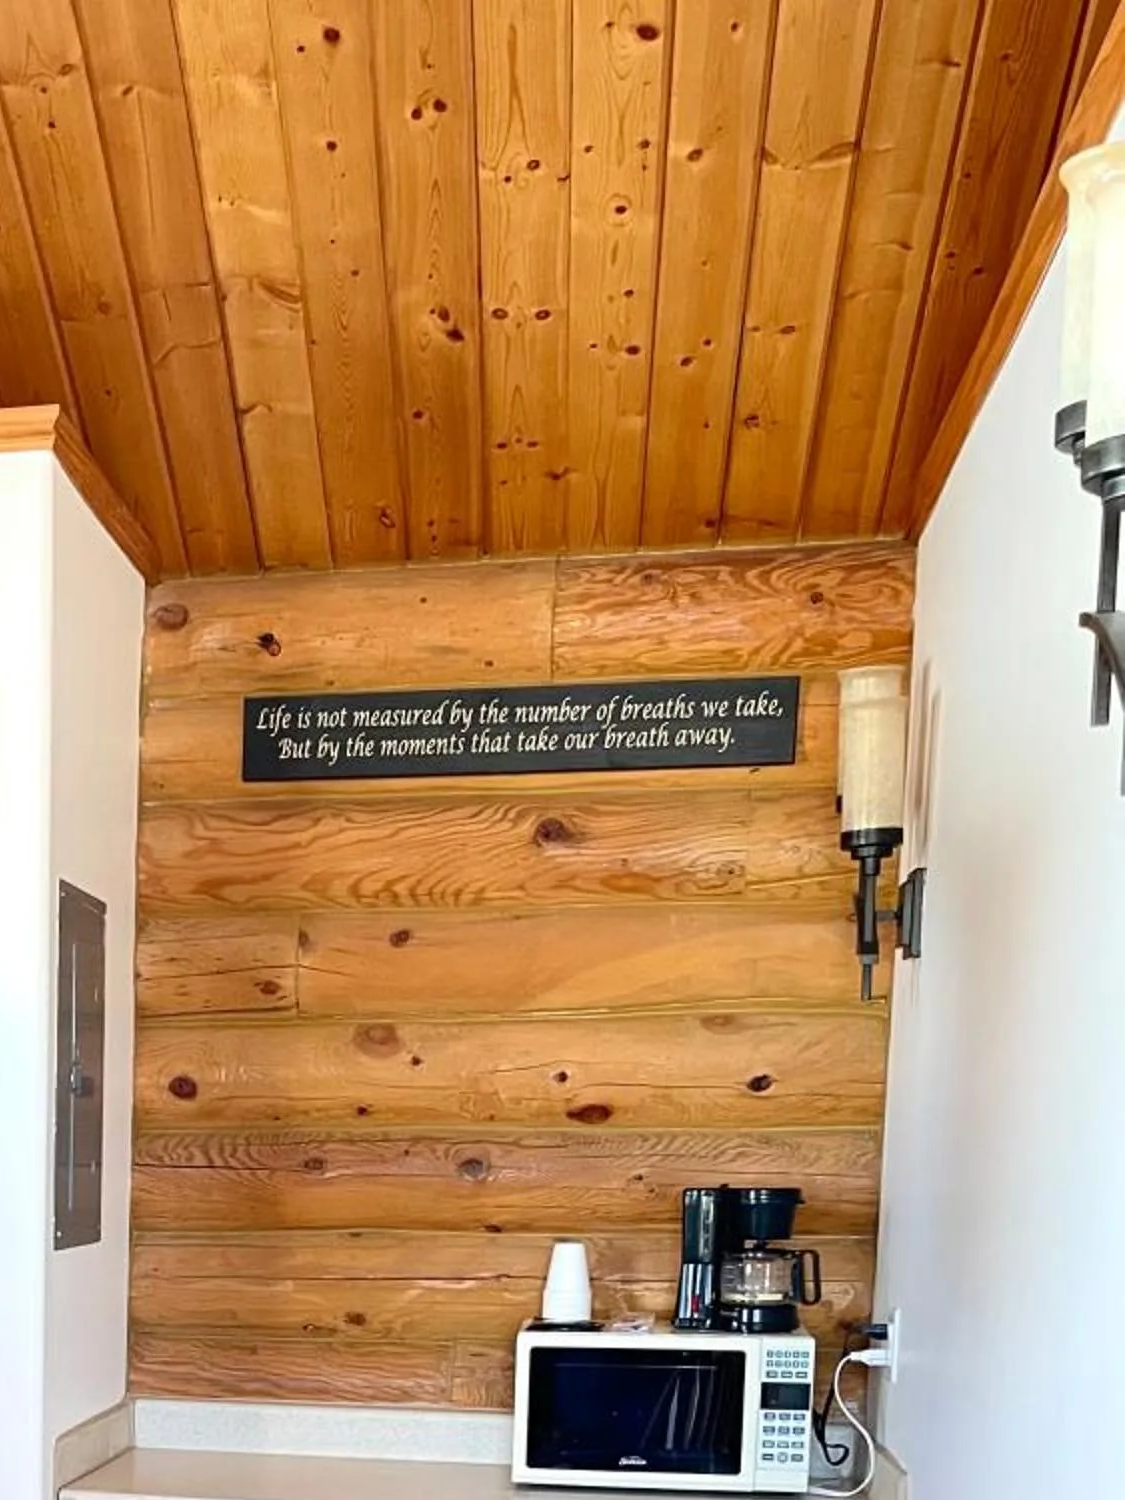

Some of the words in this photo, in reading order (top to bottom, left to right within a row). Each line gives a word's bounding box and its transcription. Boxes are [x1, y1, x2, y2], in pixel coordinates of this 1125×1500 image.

[256, 703, 292, 737] Life
[297, 707, 310, 729] is
[316, 707, 347, 728] not
[353, 699, 449, 728] measured
[449, 699, 474, 733] by
[478, 698, 508, 724] the
[515, 696, 592, 723] number
[596, 695, 619, 729] of
[620, 693, 695, 721] breaths
[700, 698, 728, 718] we
[734, 691, 783, 717] take,
[278, 737, 312, 760] But
[316, 733, 340, 767] by
[346, 732, 375, 757] the
[379, 736, 465, 756] moments
[470, 728, 511, 753] that
[516, 726, 559, 752] take
[564, 731, 599, 749] our
[604, 722, 669, 749] breath
[674, 725, 735, 753] away.
